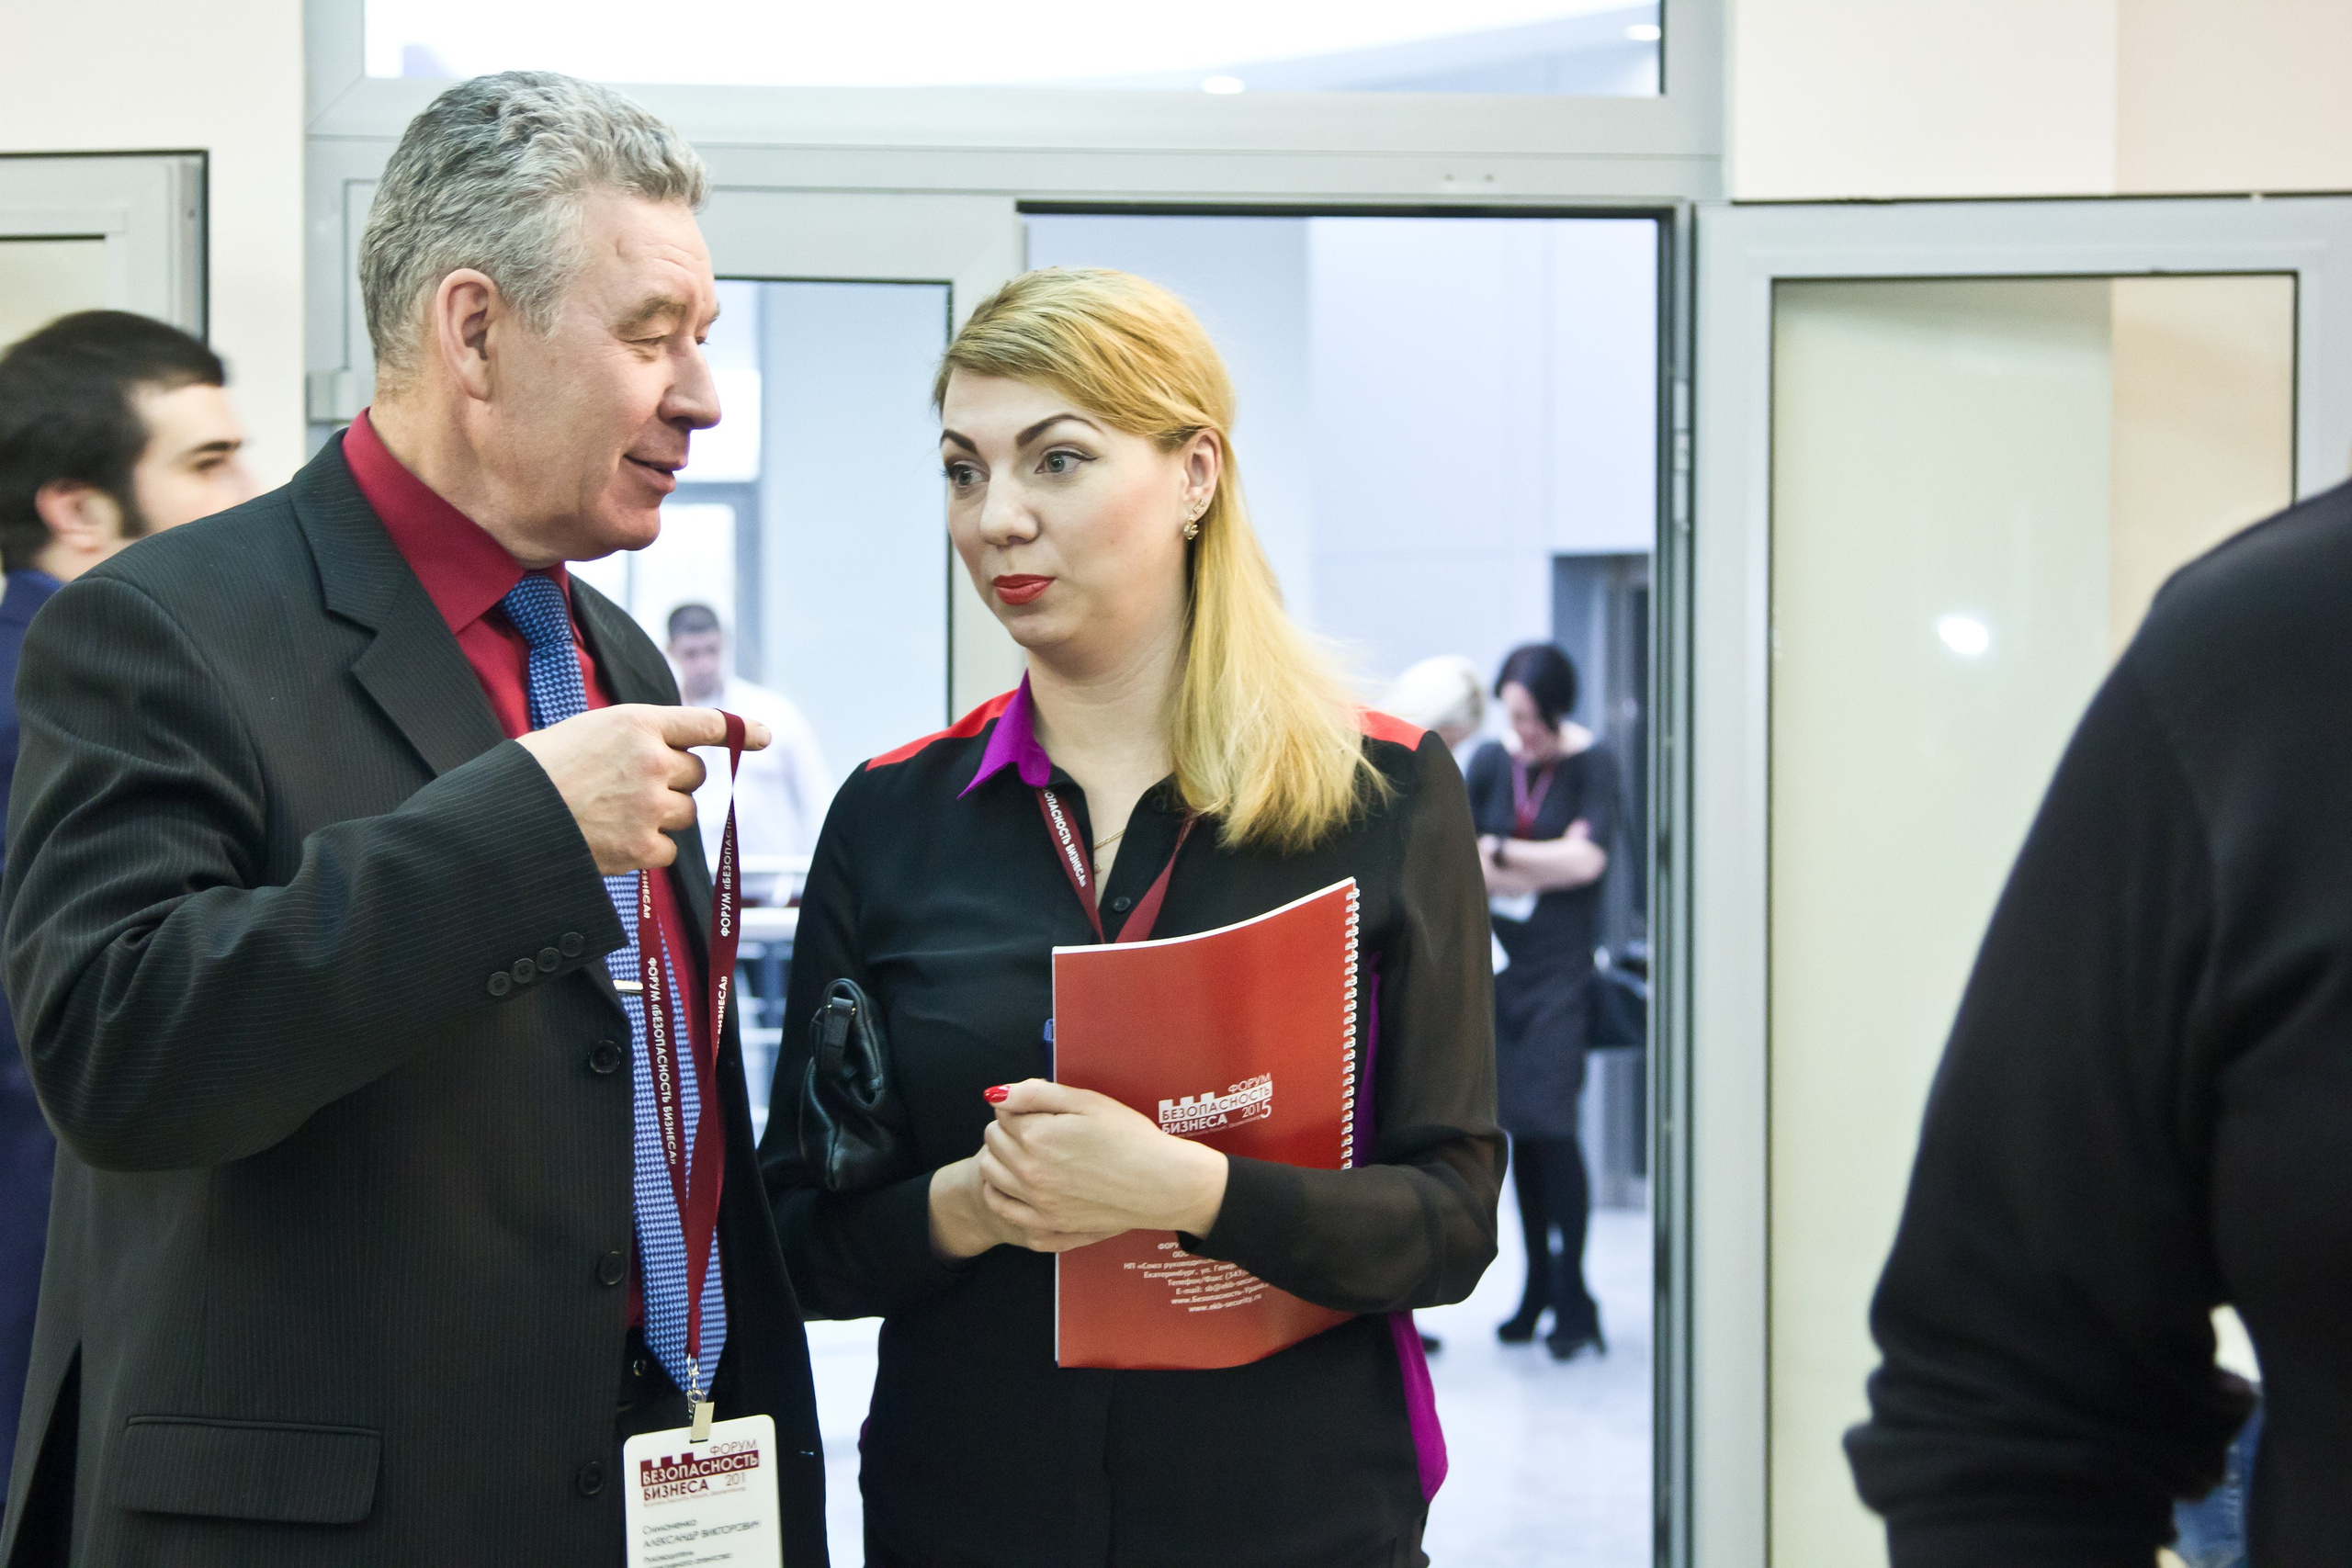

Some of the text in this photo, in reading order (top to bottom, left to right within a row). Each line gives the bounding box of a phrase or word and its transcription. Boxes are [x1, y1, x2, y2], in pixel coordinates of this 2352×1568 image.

[1044, 789, 1071, 844] ОПАСНОСТЬ
[720, 893, 731, 936] ФОРУМ
[648, 957, 677, 1165] ФОРУМ «БЕЗОПАСНОСТЬ БИЗНЕСА»
[1228, 1072, 1271, 1093] ФОРУМ
[1161, 1085, 1271, 1121] БЕЗОПАСНОСТЬ
[1161, 1113, 1228, 1134] БИЗНЕСА
[1242, 1098, 1272, 1119] 2015
[710, 1439, 757, 1456] ФОРУМ
[642, 1452, 759, 1485] БЕЗОПАСНОСТЬ
[644, 1479, 709, 1501] БИЗНЕСА
